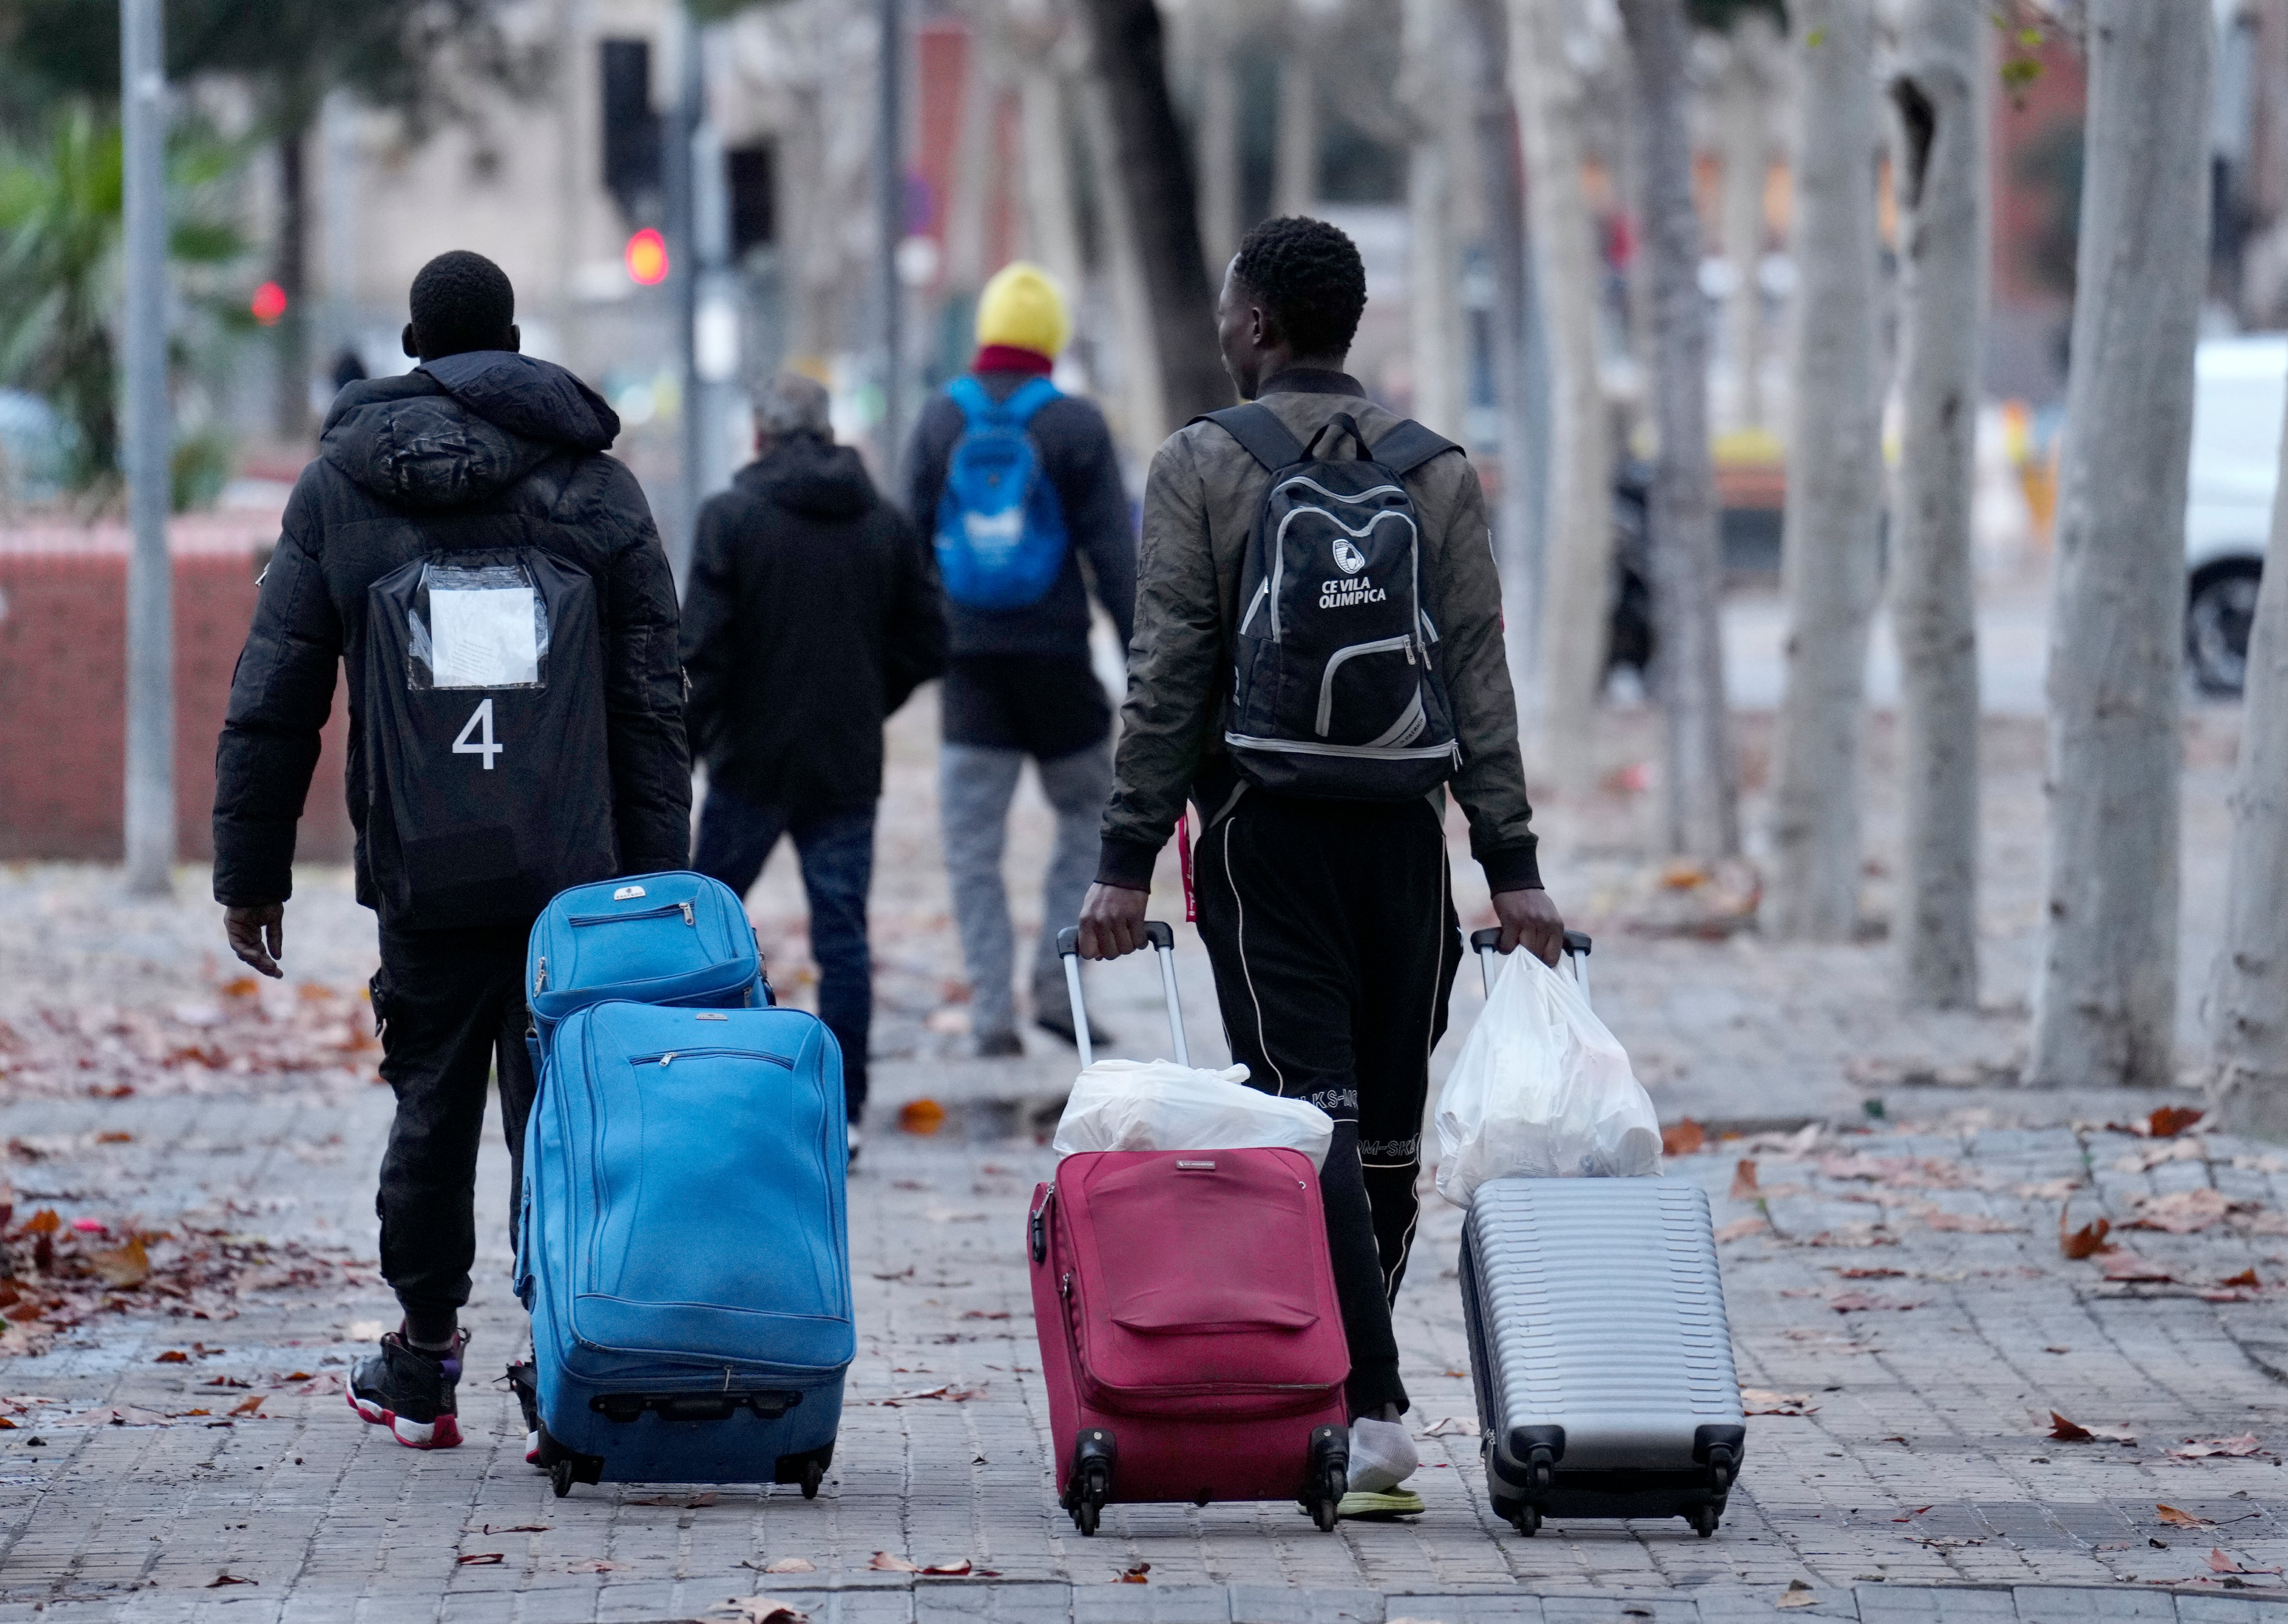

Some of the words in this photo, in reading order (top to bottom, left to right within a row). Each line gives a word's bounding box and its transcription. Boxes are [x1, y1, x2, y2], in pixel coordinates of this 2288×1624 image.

[1322, 580, 1338, 594] CE
[1339, 577, 1371, 592] VILA
[1319, 588, 1386, 609] OLIMPICA
[452, 698, 503, 770] 4
